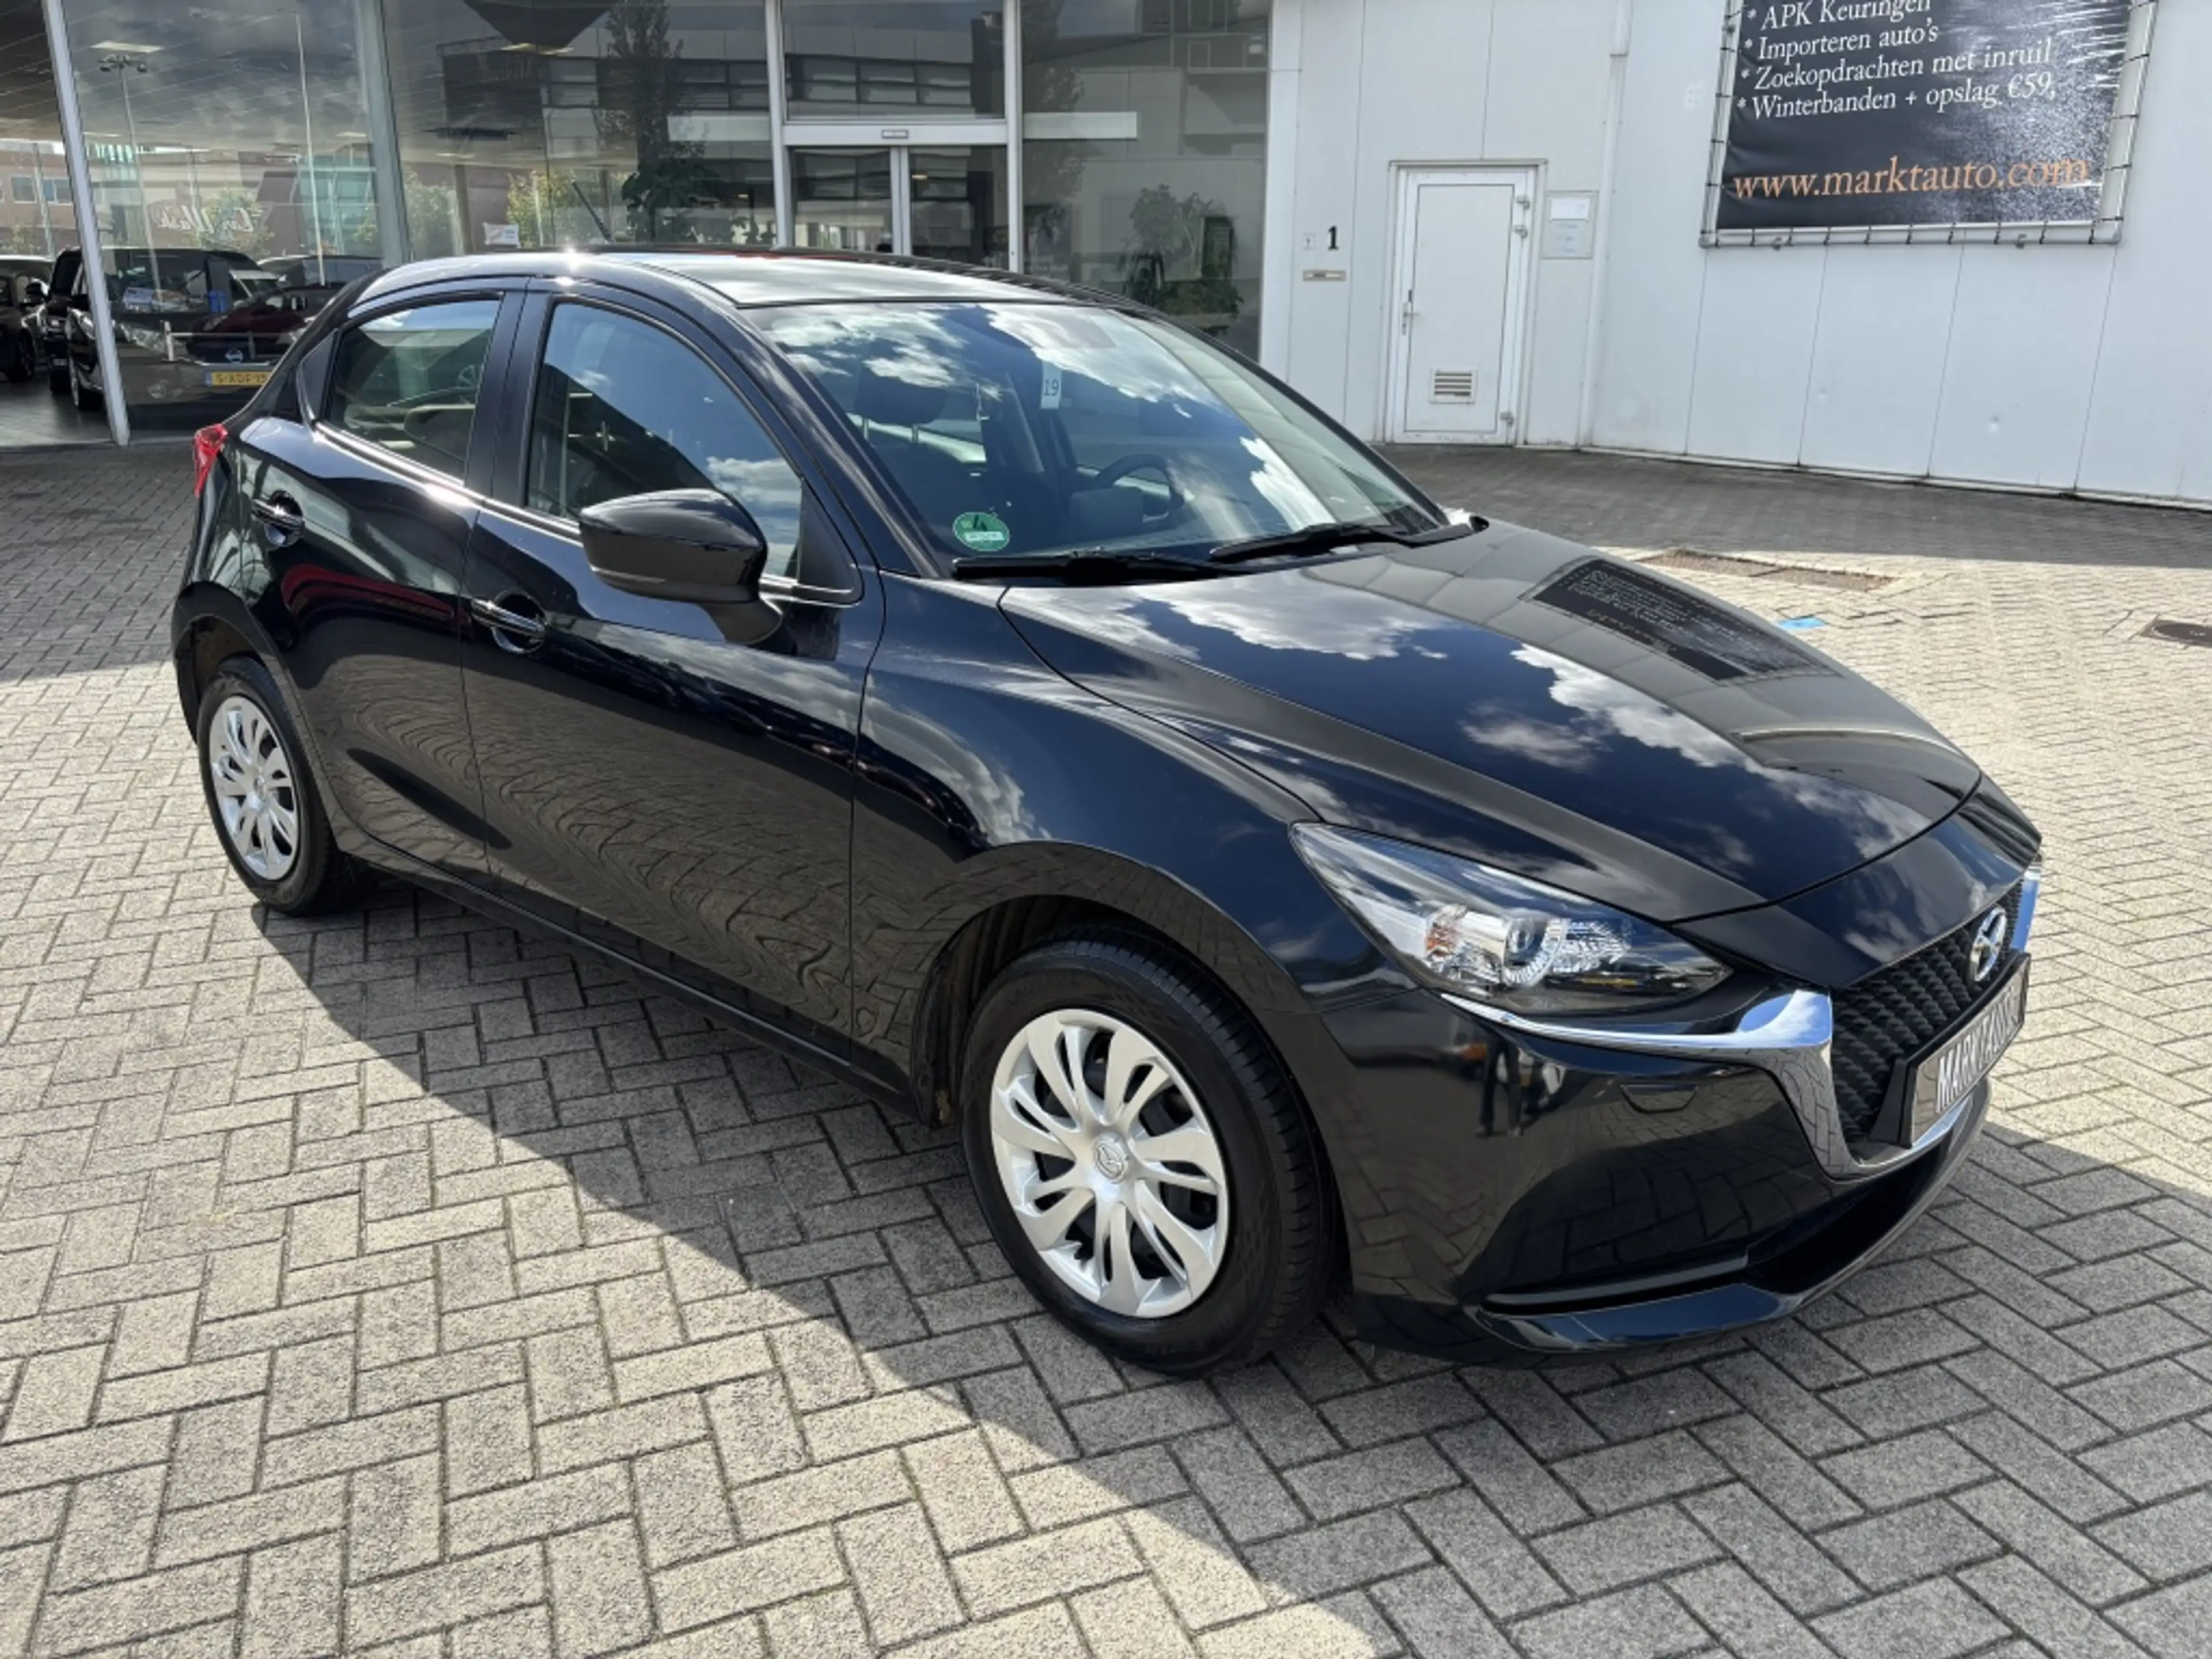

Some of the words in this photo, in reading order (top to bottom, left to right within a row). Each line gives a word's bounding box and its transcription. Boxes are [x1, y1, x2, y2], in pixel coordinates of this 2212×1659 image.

[1760, 2, 1813, 31] APK
[1820, 0, 1930, 22] Keuringen
[1758, 33, 1871, 66] Importeren
[1879, 17, 1939, 47] auto's
[1755, 54, 1923, 92] Zoekopdrachten
[1931, 51, 1976, 74] met
[1984, 37, 2051, 69] inruil
[1752, 86, 1896, 119] Winterbanden
[1905, 91, 1917, 105] +
[1733, 155, 2089, 199] www.marktauto.com
[1327, 225, 1339, 251] 1
[1044, 378, 1059, 396] 19
